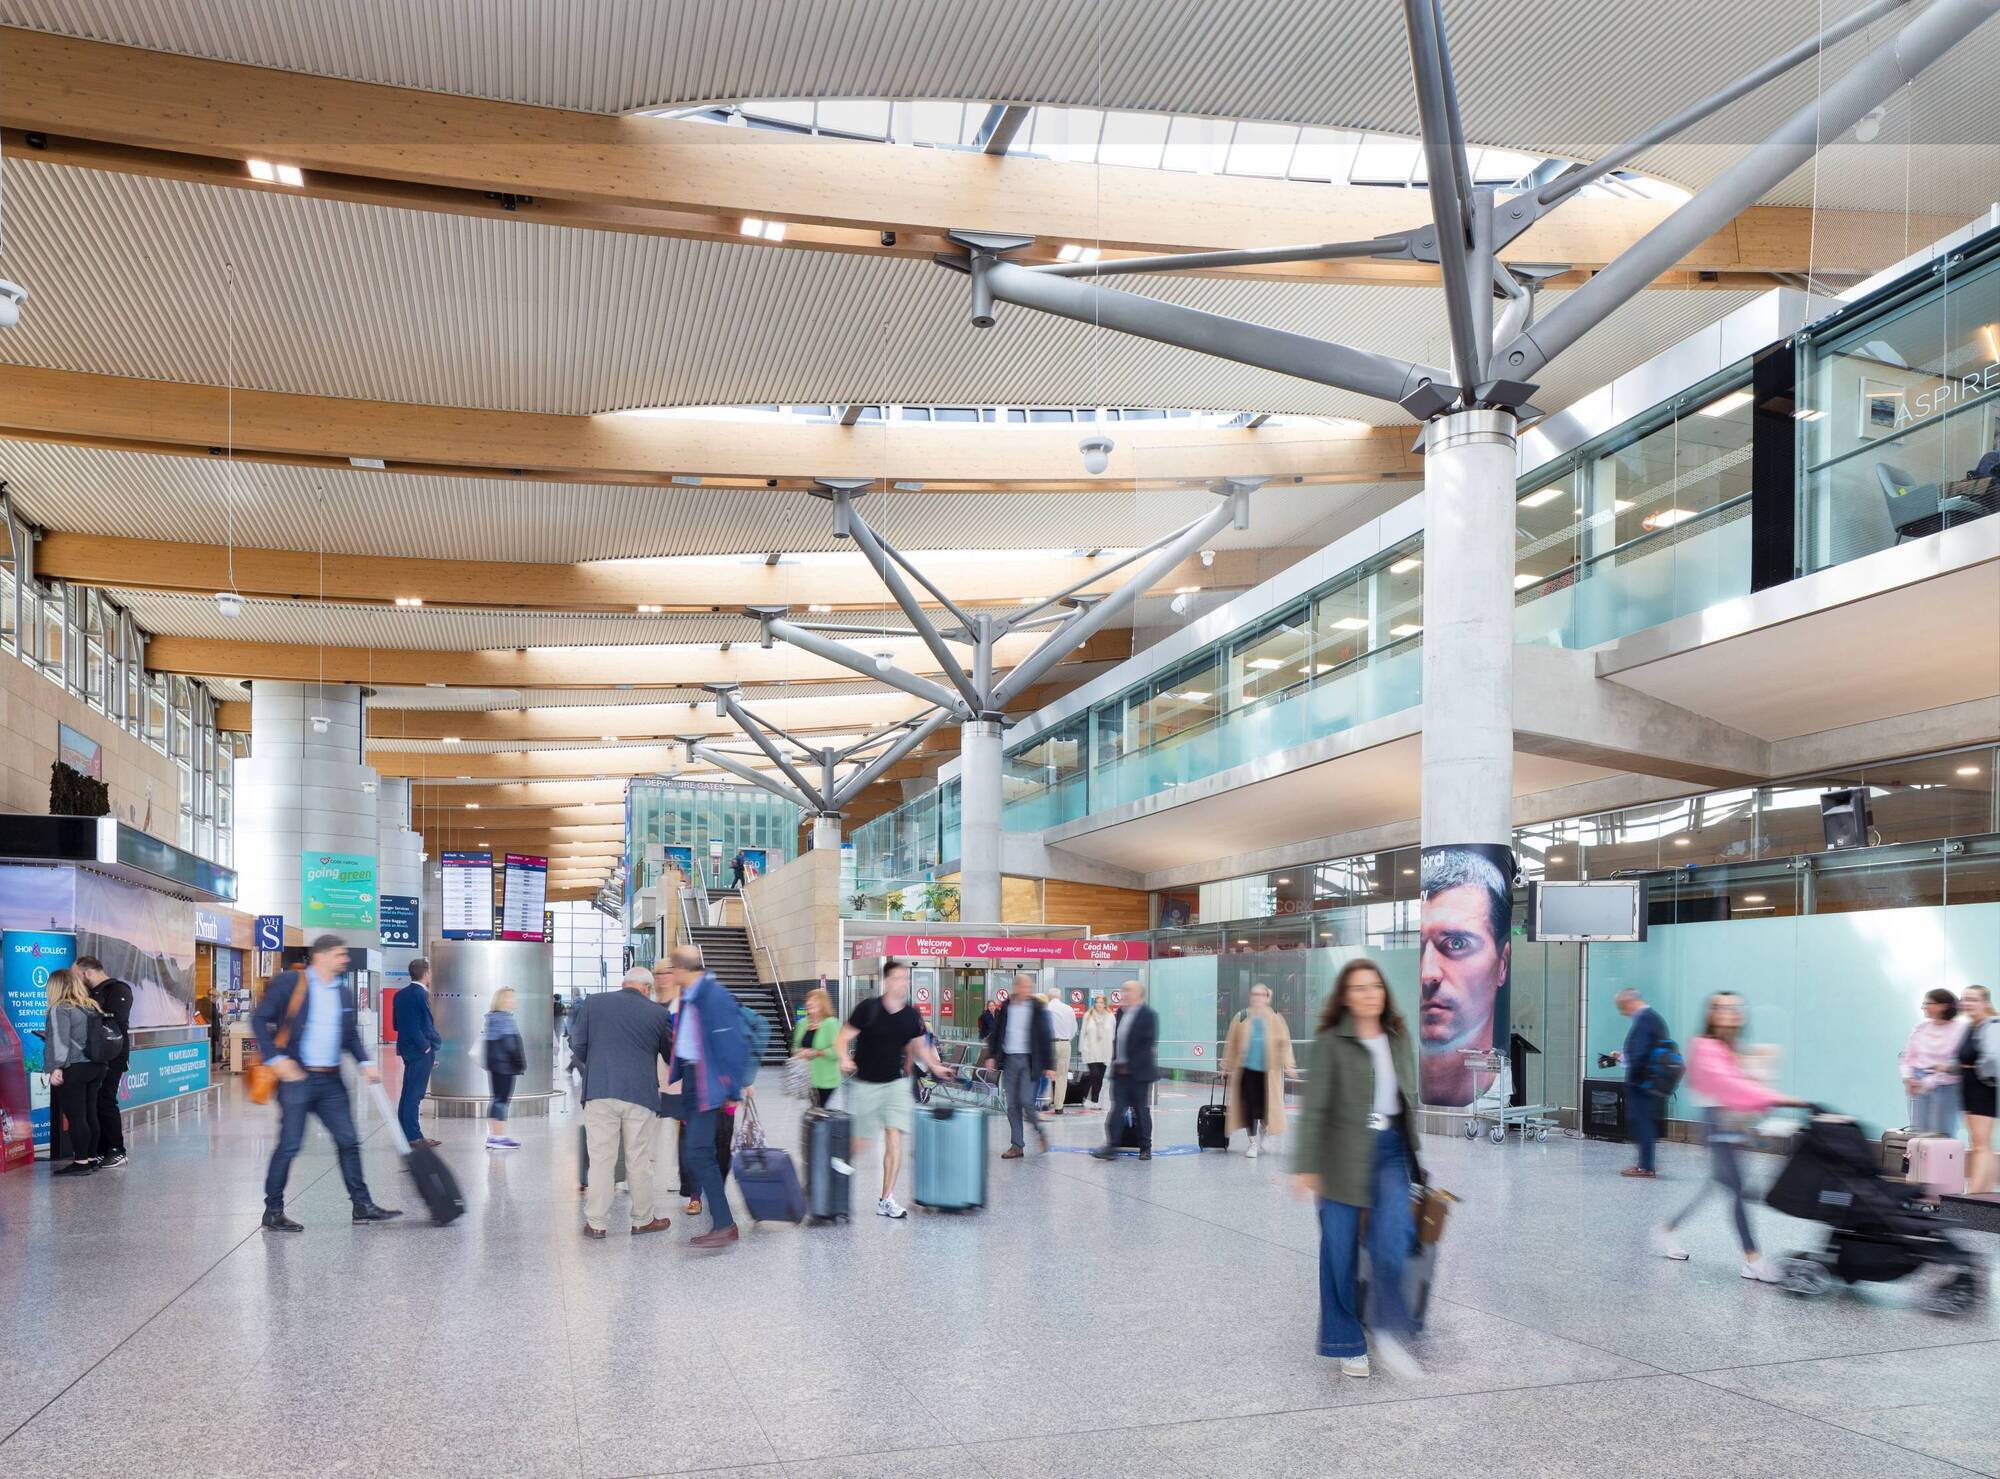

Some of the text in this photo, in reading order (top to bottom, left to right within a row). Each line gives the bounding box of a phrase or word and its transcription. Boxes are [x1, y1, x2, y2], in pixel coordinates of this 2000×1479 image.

[1893, 363, 2000, 428] ASPIRE
[697, 783, 725, 792] GATES
[1421, 851, 1445, 868] ord
[308, 867, 372, 883] going green
[262, 917, 280, 926] WH
[262, 925, 280, 950] S
[916, 939, 953, 947] Welcome
[15, 945, 33, 953] SHOP
[40, 947, 67, 955] COLLECT
[1083, 942, 1101, 951] Céad
[127, 1072, 149, 1090] COLLECT
